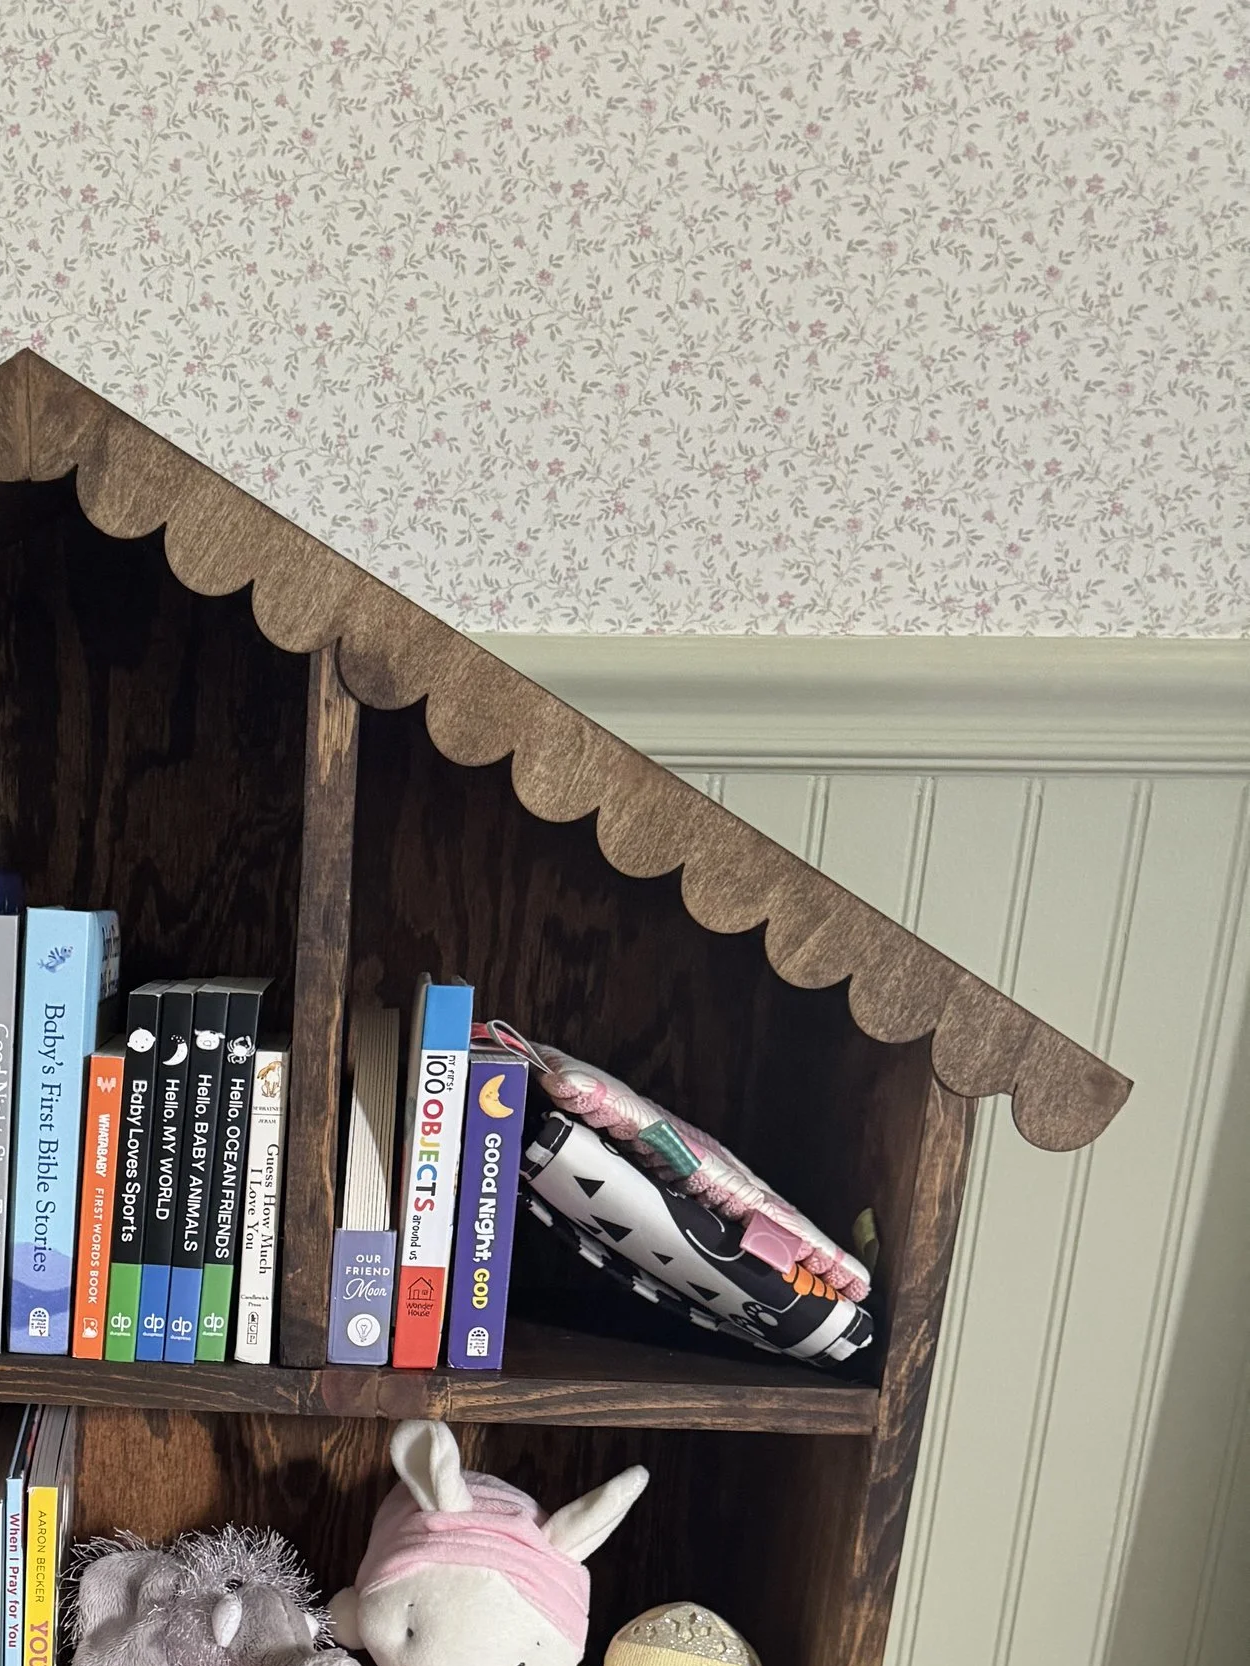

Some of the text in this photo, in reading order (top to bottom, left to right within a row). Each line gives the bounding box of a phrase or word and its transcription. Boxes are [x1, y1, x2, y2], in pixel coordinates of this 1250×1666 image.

[32, 1003, 66, 1272] Baby's First Bible Stories
[156, 1078, 180, 1221] Hello, MY WORLD
[121, 1079, 148, 1242] Baby Loves Sports
[184, 1074, 212, 1252] Hello, BABY ANIMALS
[216, 1078, 246, 1260] Hello, OCEAN FRIENDS
[409, 1056, 448, 1260] 100 OBJECTS around us
[88, 1113, 110, 1304] WHATABABY FIRST WORDS BOOK
[248, 1180, 260, 1216] Love
[258, 1143, 280, 1276] Guess How Much
[245, 1222, 259, 1250] You
[472, 1132, 502, 1310] Good Night, GOD
[346, 1266, 390, 1276] FRIEND
[356, 1254, 382, 1264] OUR
[342, 1278, 387, 1301] Moon
[406, 1302, 434, 1310] Wonder
[110, 1312, 132, 1332] dp
[144, 1313, 164, 1332] dp
[172, 1316, 192, 1336] dp
[204, 1312, 224, 1332] dp
[9, 1513, 20, 1552] When
[34, 1510, 47, 1604] AARON BECKER
[7, 1566, 20, 1596] Pray
[9, 1598, 20, 1618] for
[8, 1623, 19, 1648] You
